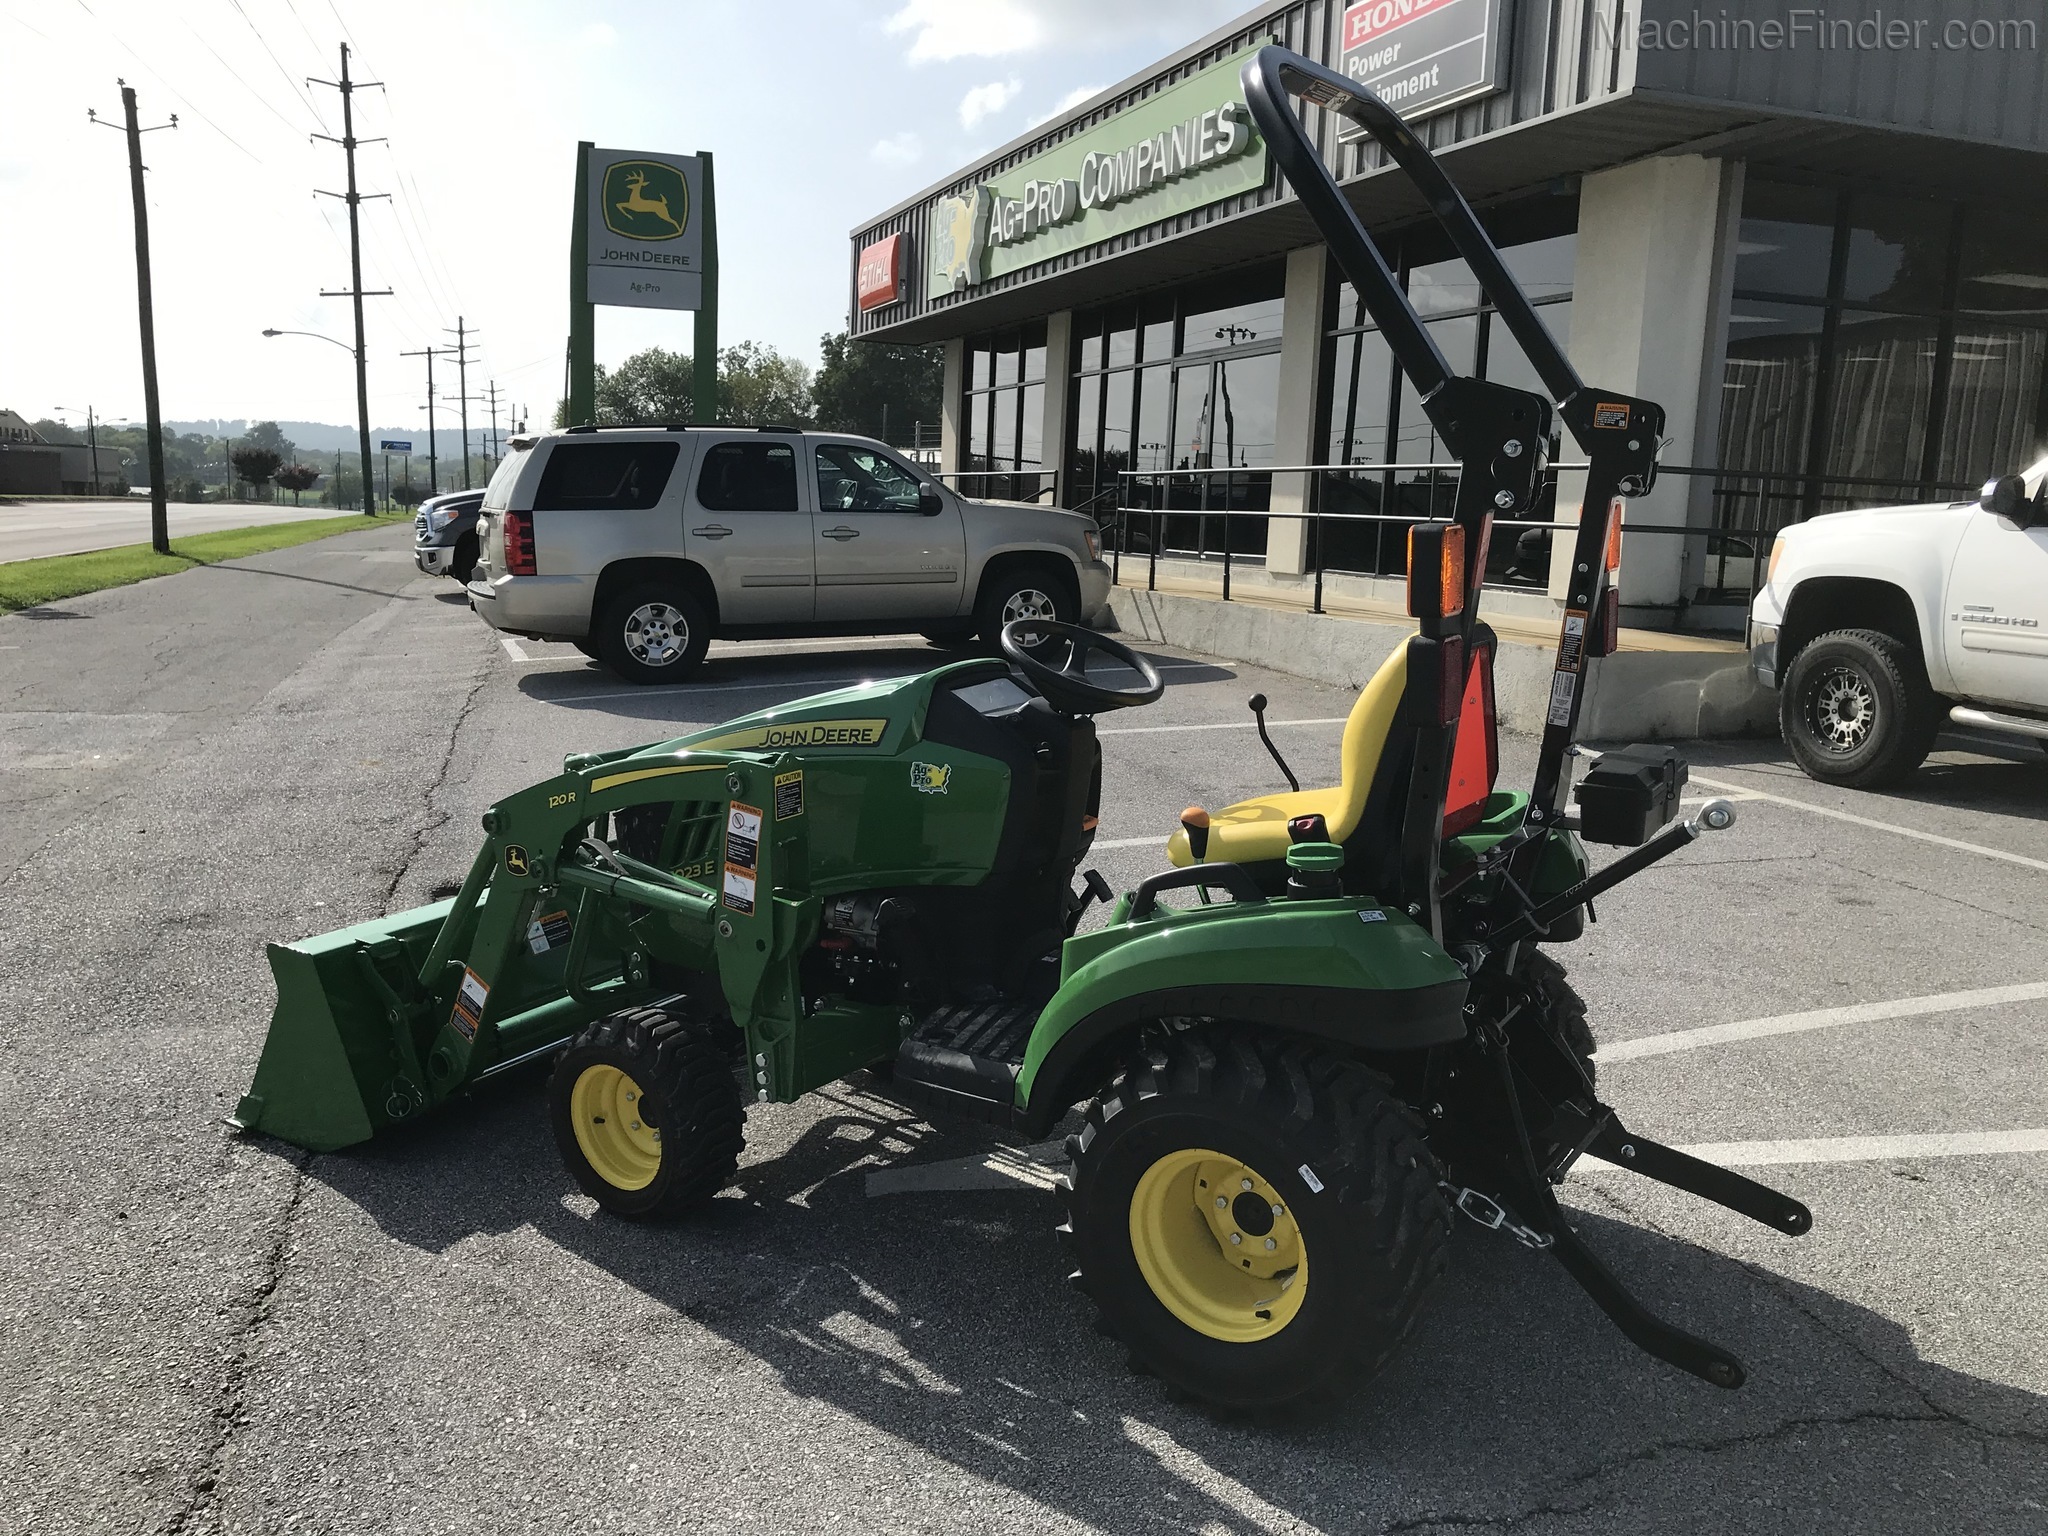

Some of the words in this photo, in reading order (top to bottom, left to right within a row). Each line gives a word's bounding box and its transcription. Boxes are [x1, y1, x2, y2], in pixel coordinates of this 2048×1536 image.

[1351, 0, 1437, 40] HON
[1349, 43, 1401, 78] Power
[1376, 63, 1439, 104] ipment
[1079, 100, 1241, 209] COMPANIES
[600, 248, 640, 262] JOHN
[642, 250, 690, 266] DEERE
[629, 282, 661, 293] Ag-Pro
[860, 256, 889, 291] STIHL
[759, 729, 808, 747] JOHN
[811, 726, 874, 743] DEERE
[782, 771, 802, 783] CAUTION
[673, 864, 701, 879] 023
